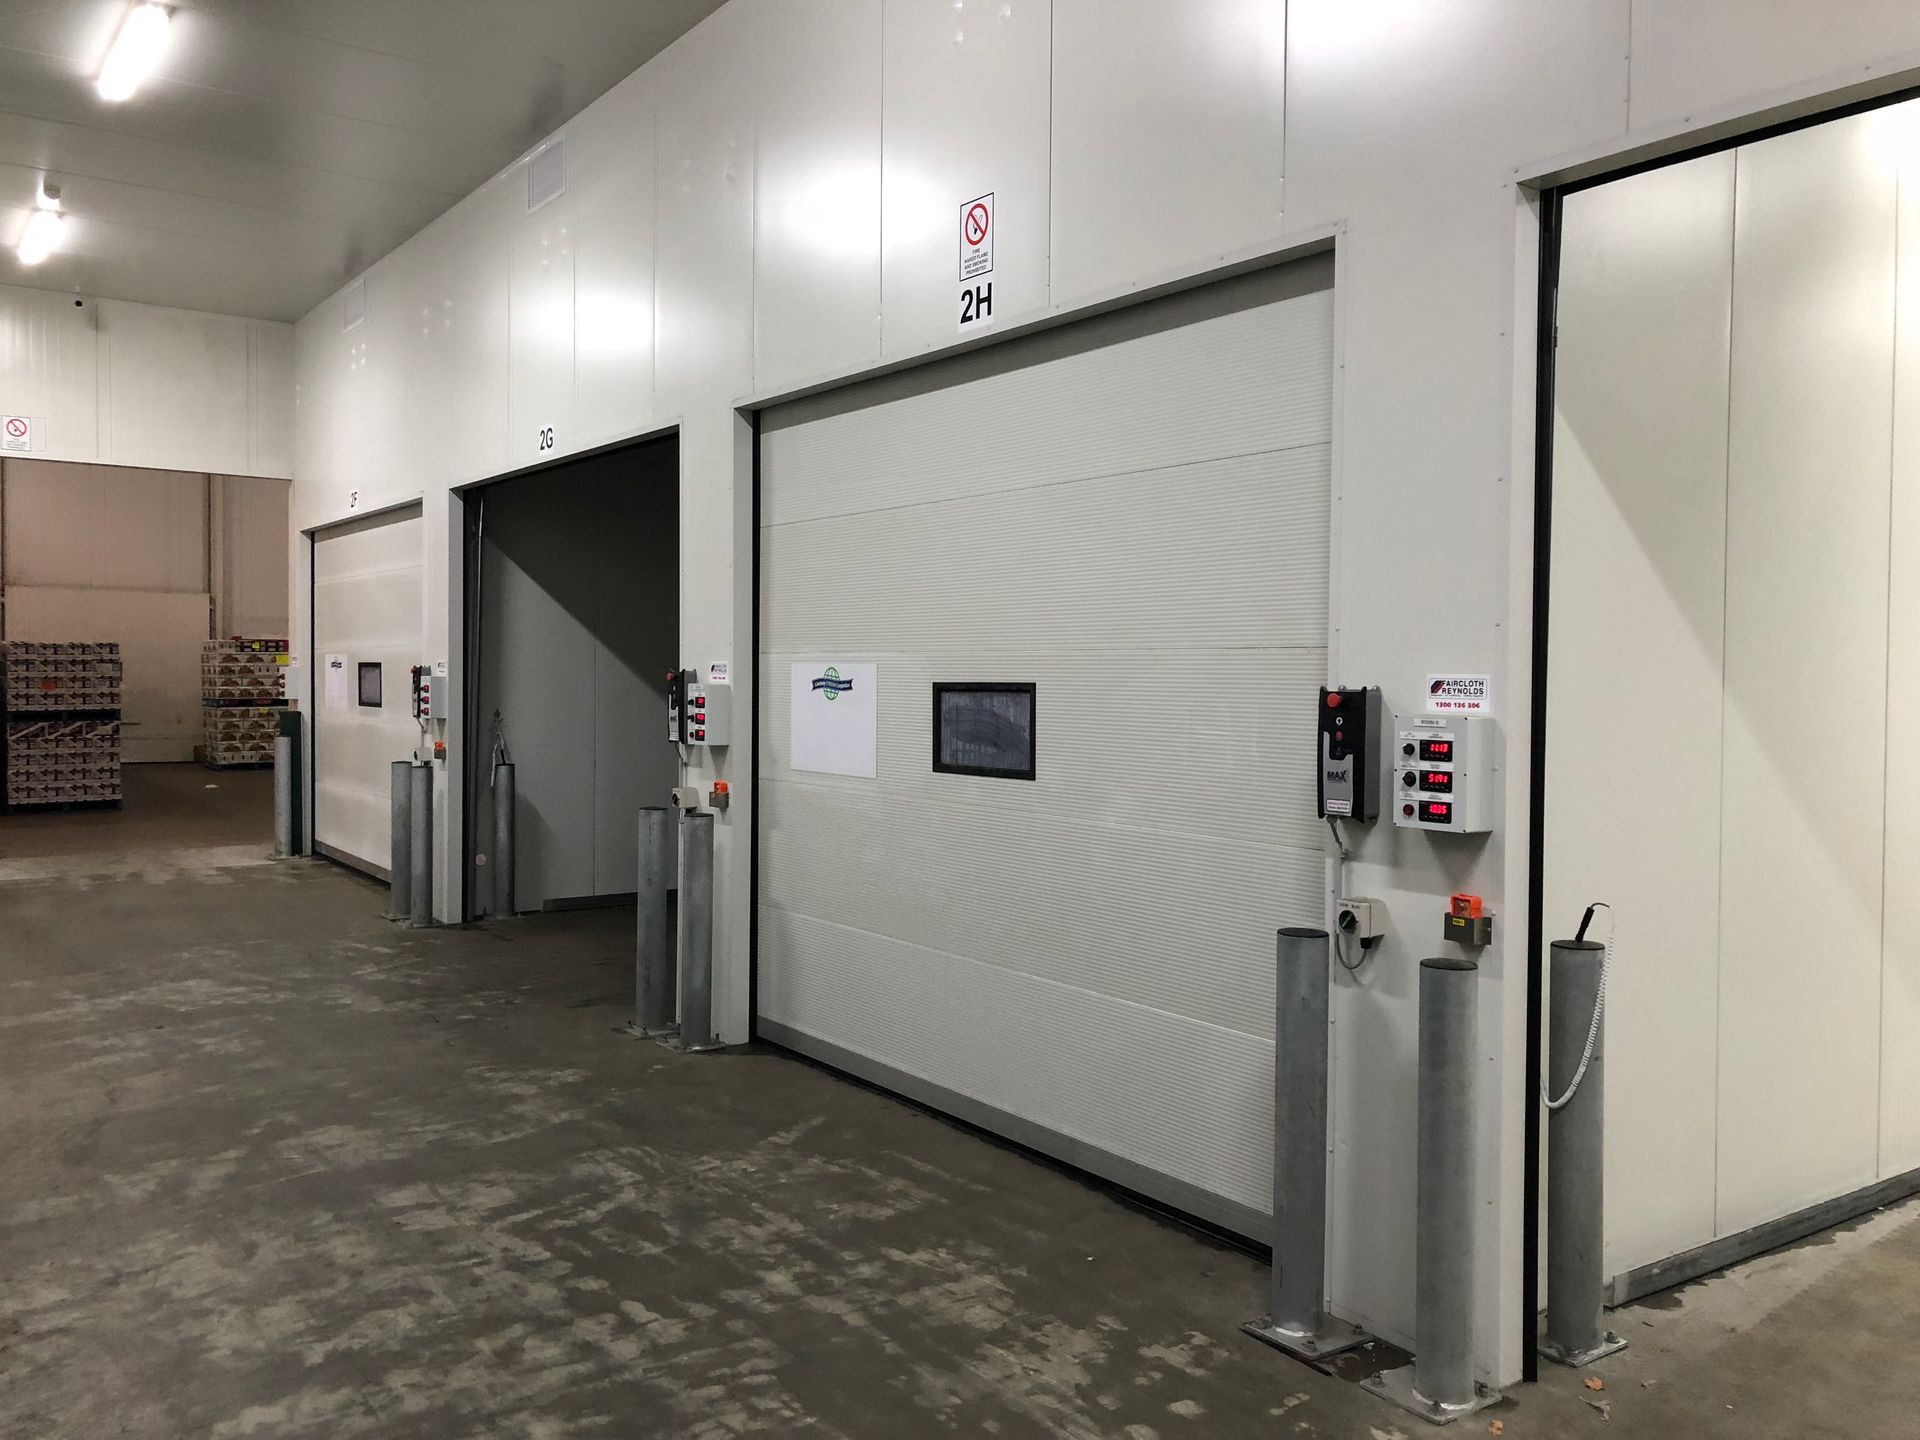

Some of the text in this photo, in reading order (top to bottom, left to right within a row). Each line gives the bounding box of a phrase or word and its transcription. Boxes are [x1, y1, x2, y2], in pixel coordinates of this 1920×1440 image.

[960, 282, 992, 324] 2H
[540, 427, 553, 450] 2G
[350, 491, 358, 508] 2F
[1327, 770, 1347, 783] MAX
